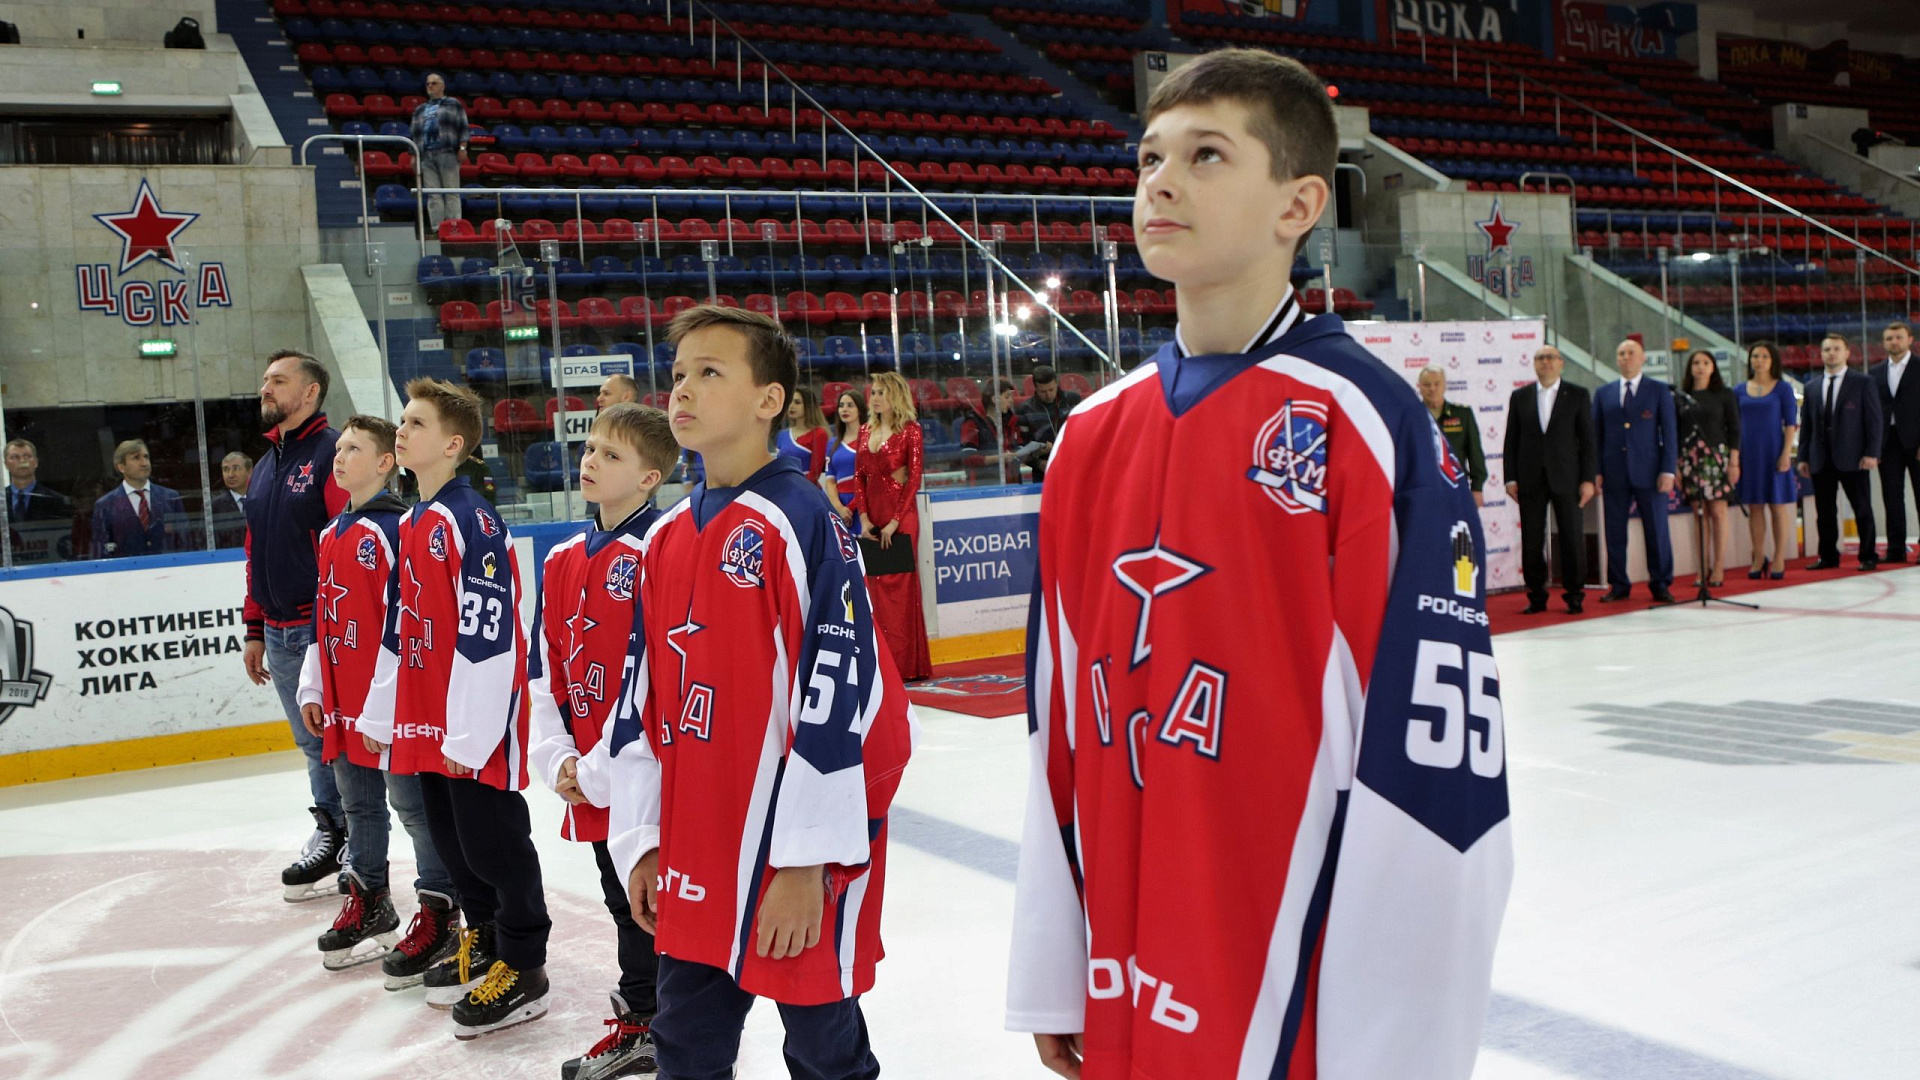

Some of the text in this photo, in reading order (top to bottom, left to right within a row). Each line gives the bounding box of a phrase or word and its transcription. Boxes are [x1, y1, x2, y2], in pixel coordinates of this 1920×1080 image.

[76, 262, 232, 326] ЦСКА
[555, 366, 598, 375] ОГАЗ
[935, 560, 1012, 585] РУППА
[458, 591, 502, 641] 33
[9, 688, 29, 698] 2018
[80, 671, 157, 697] ЛИГА
[1405, 639, 1504, 779] 55
